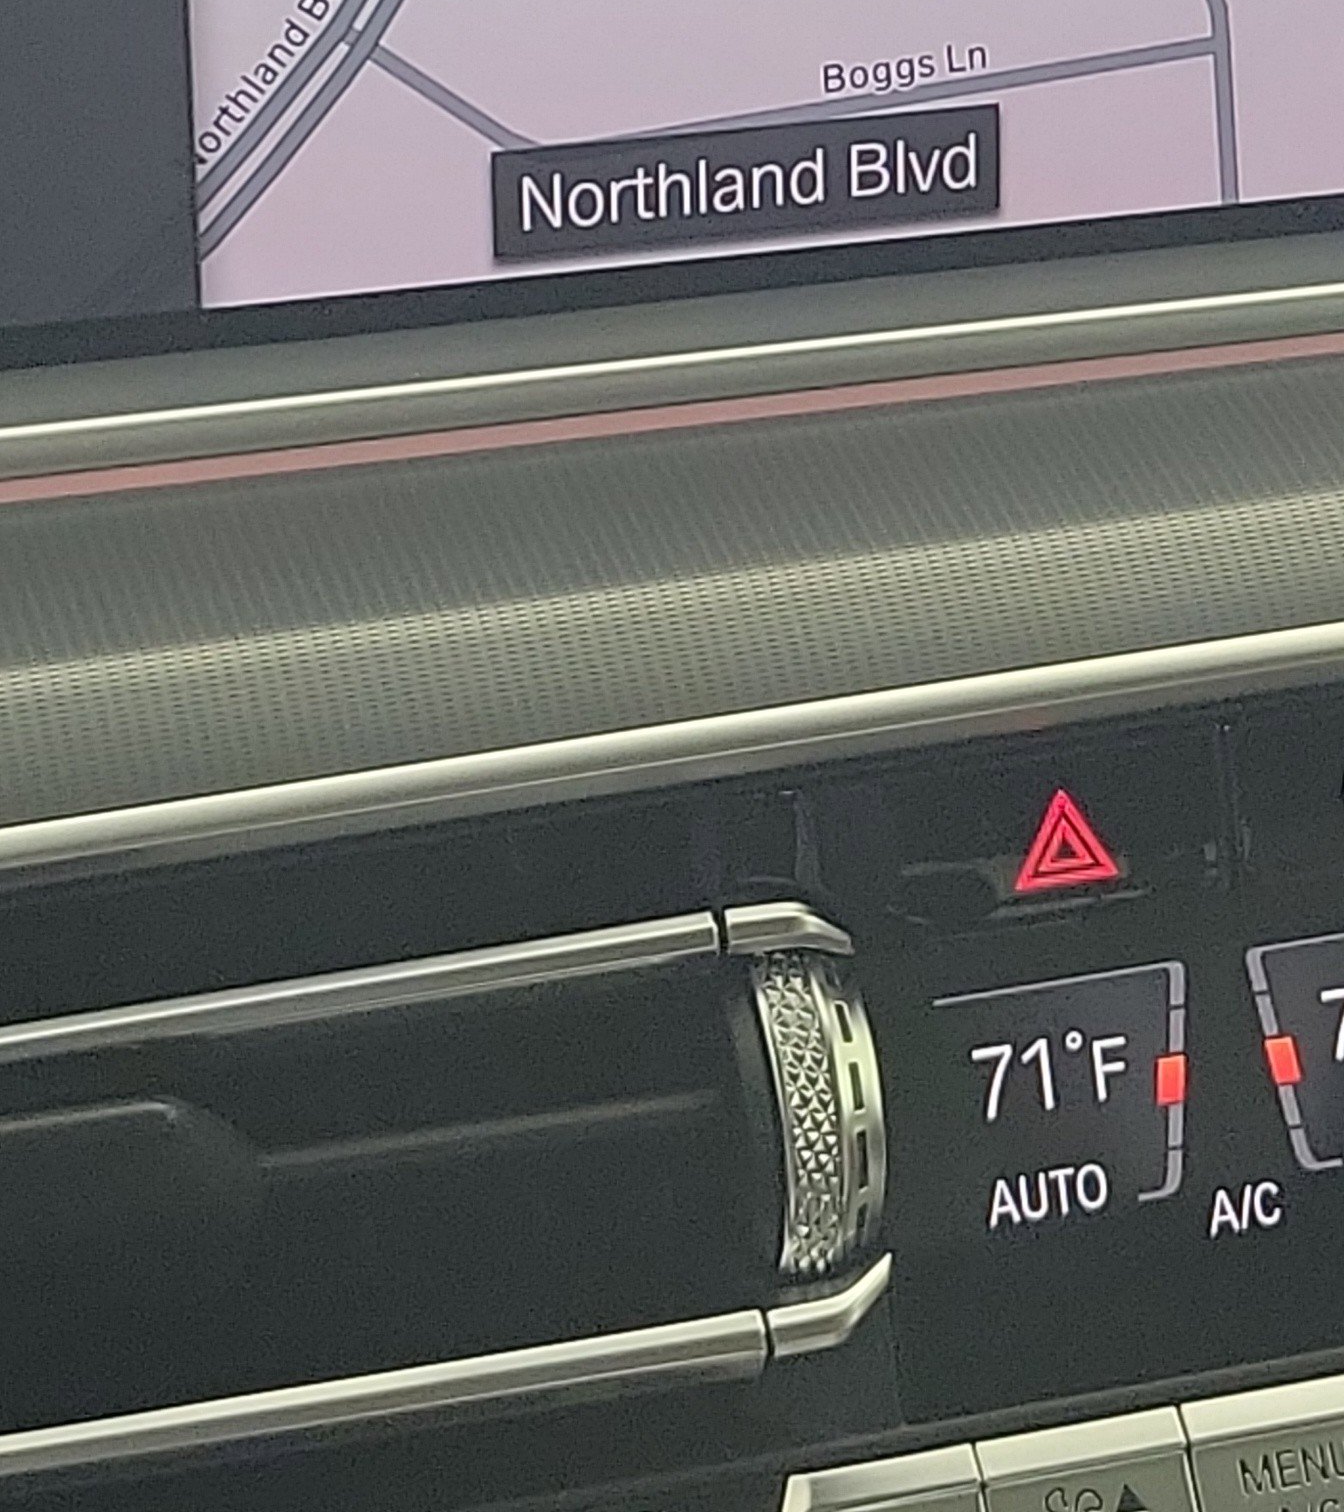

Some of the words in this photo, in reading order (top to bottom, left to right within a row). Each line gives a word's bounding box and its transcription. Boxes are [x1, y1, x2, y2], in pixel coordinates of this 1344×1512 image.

[821, 49, 936, 96] Boggs
[943, 41, 988, 75] Ln
[518, 145, 826, 232] Northland
[848, 132, 979, 198] Blvd
[989, 1162, 1108, 1229] AUTO
[1210, 1180, 1282, 1238] A/C
